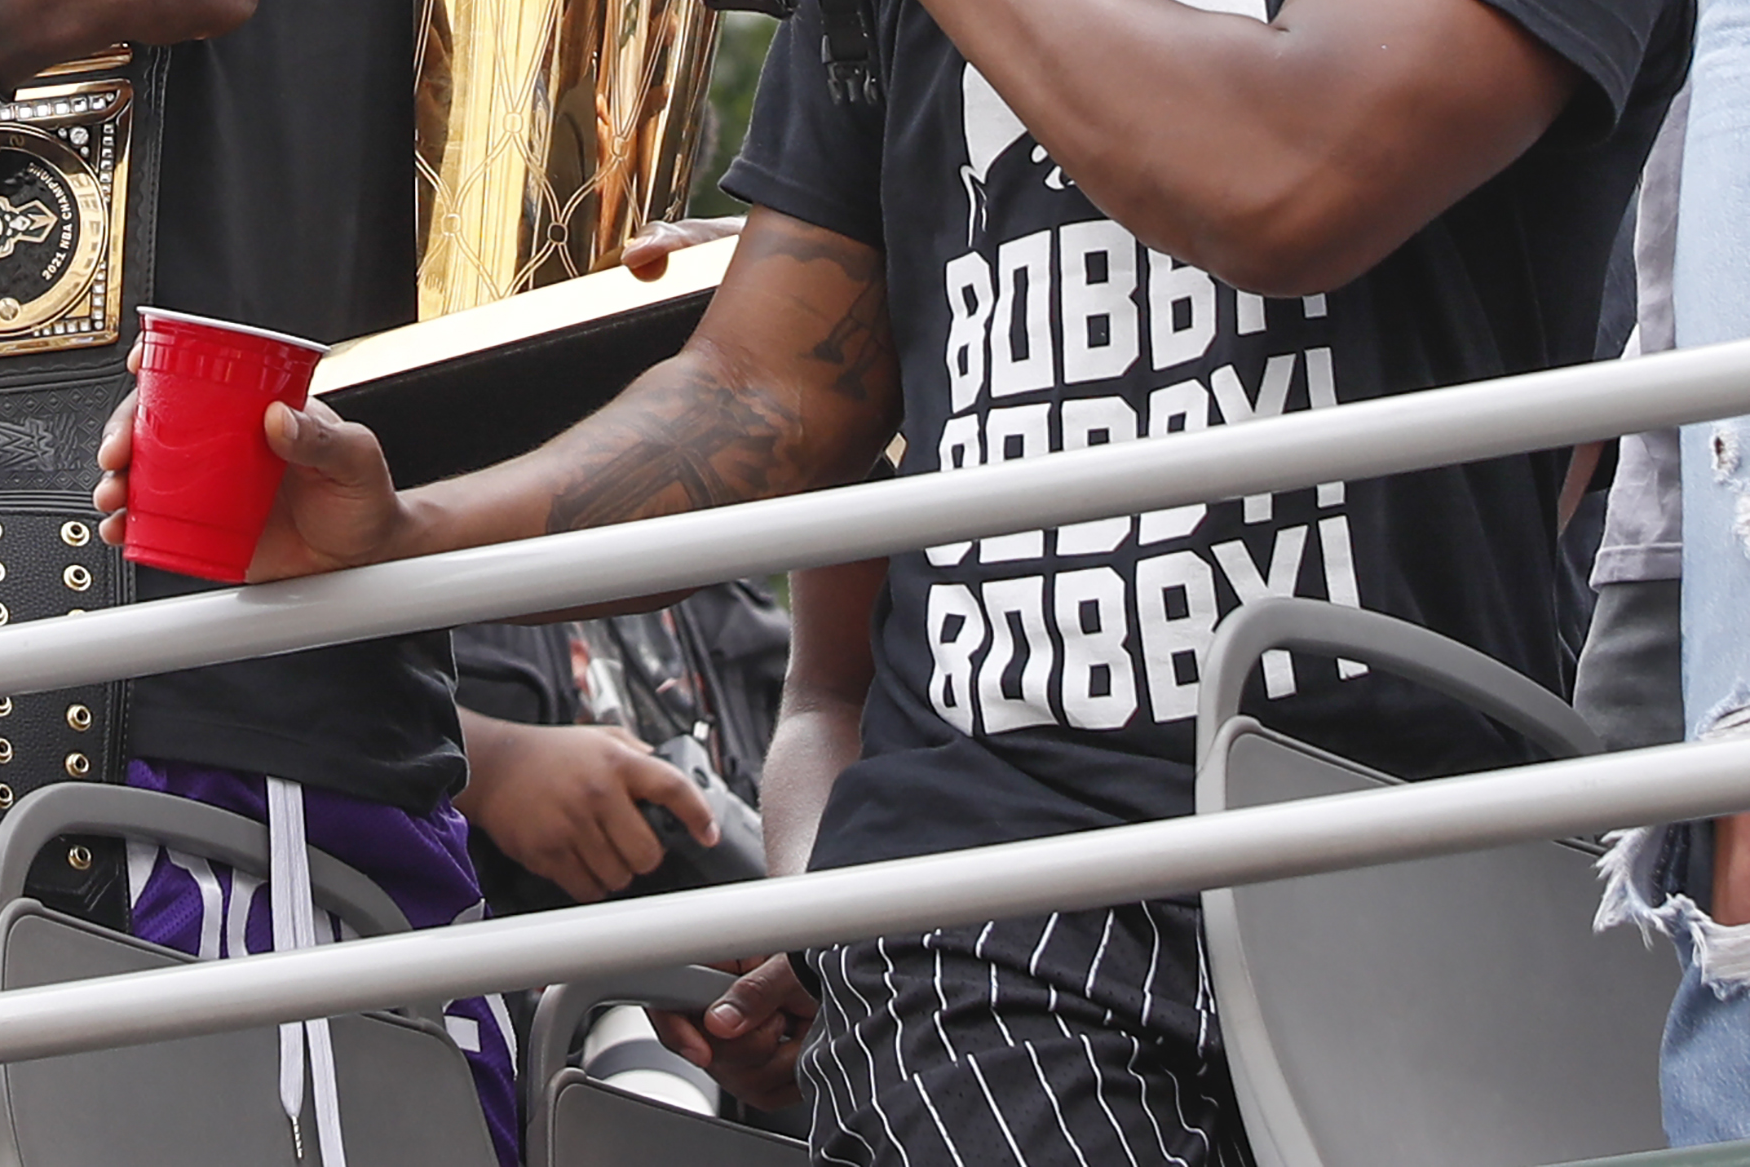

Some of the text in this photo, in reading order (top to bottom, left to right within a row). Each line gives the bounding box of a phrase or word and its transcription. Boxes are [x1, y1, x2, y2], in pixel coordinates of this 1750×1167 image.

[41, 251, 67, 281] 2021
[60, 223, 73, 249] NBA
[945, 219, 1328, 414] BOBB
